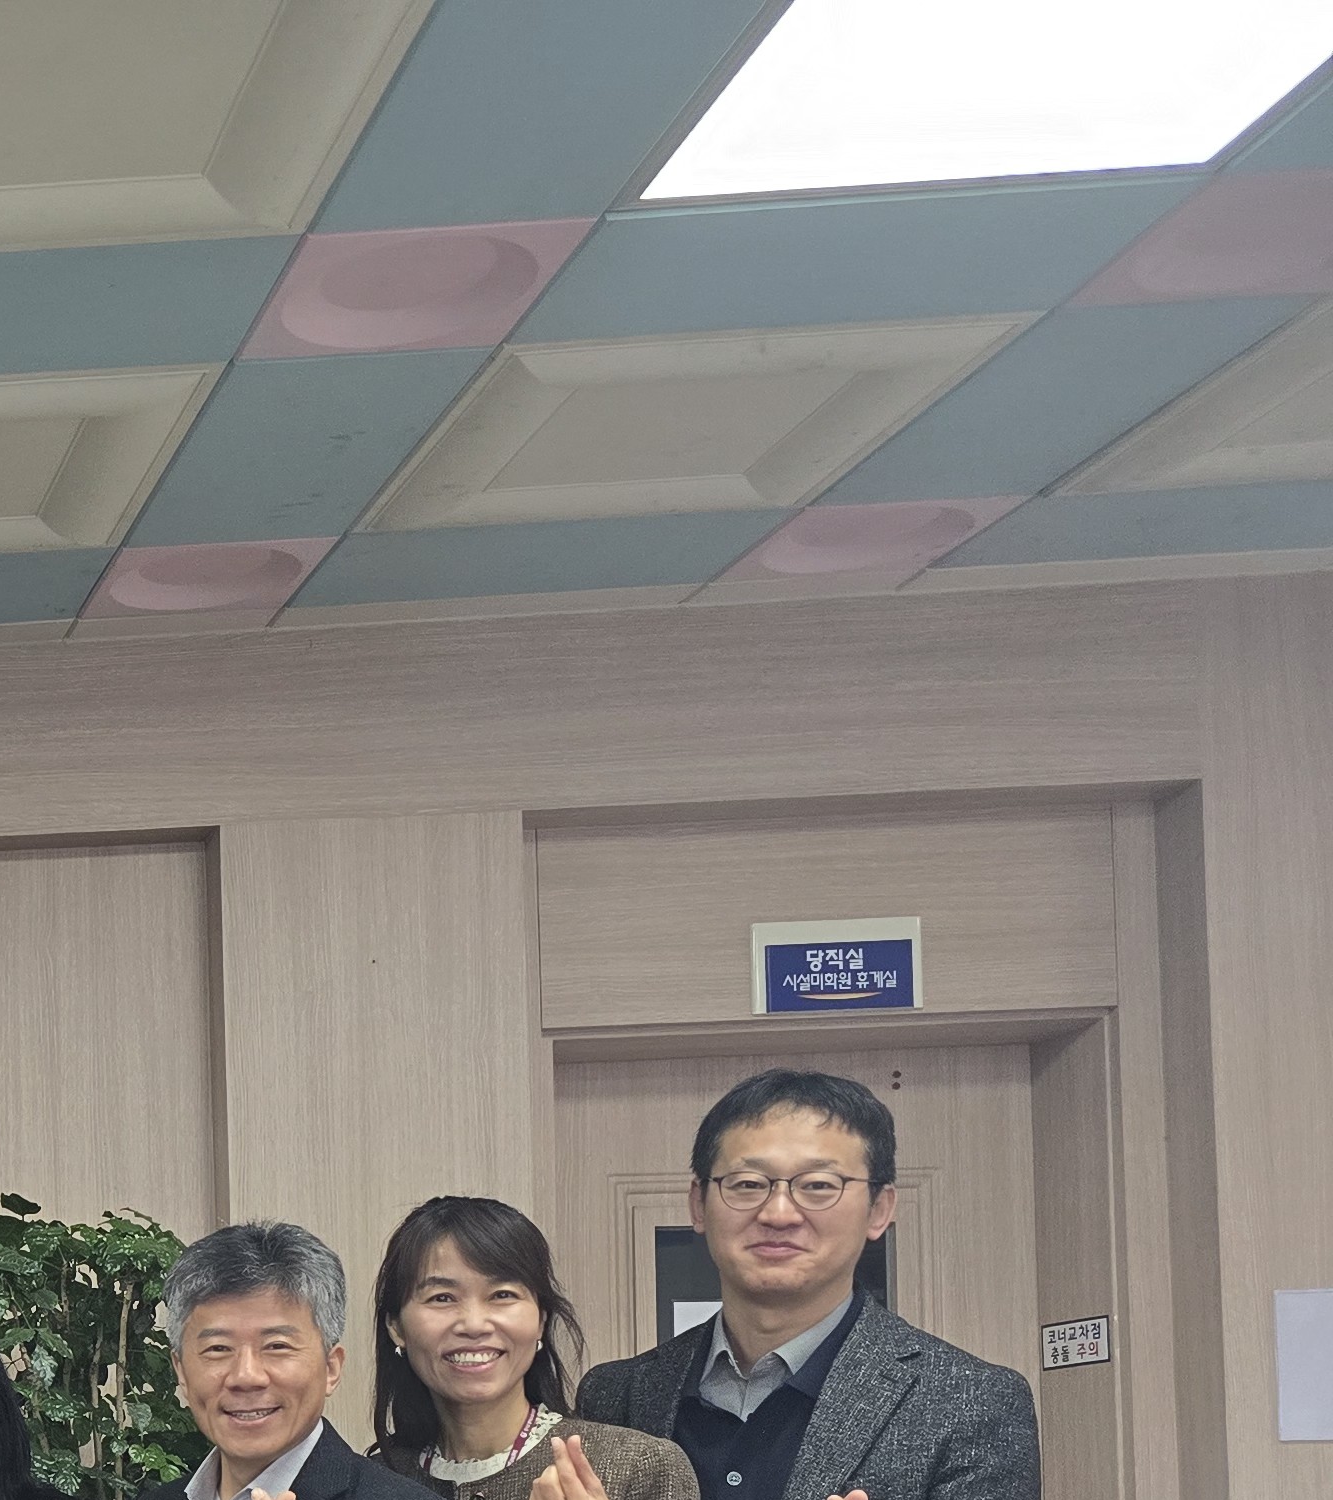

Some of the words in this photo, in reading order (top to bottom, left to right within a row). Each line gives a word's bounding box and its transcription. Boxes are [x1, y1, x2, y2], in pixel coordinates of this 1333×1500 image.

[806, 948, 864, 971] 당직실
[783, 972, 851, 991] 시설미화원
[856, 970, 897, 988] 휴게실
[1047, 1322, 1101, 1345] 코너교차점
[1050, 1345, 1070, 1365] 충돌
[1076, 1341, 1100, 1358] 주의
